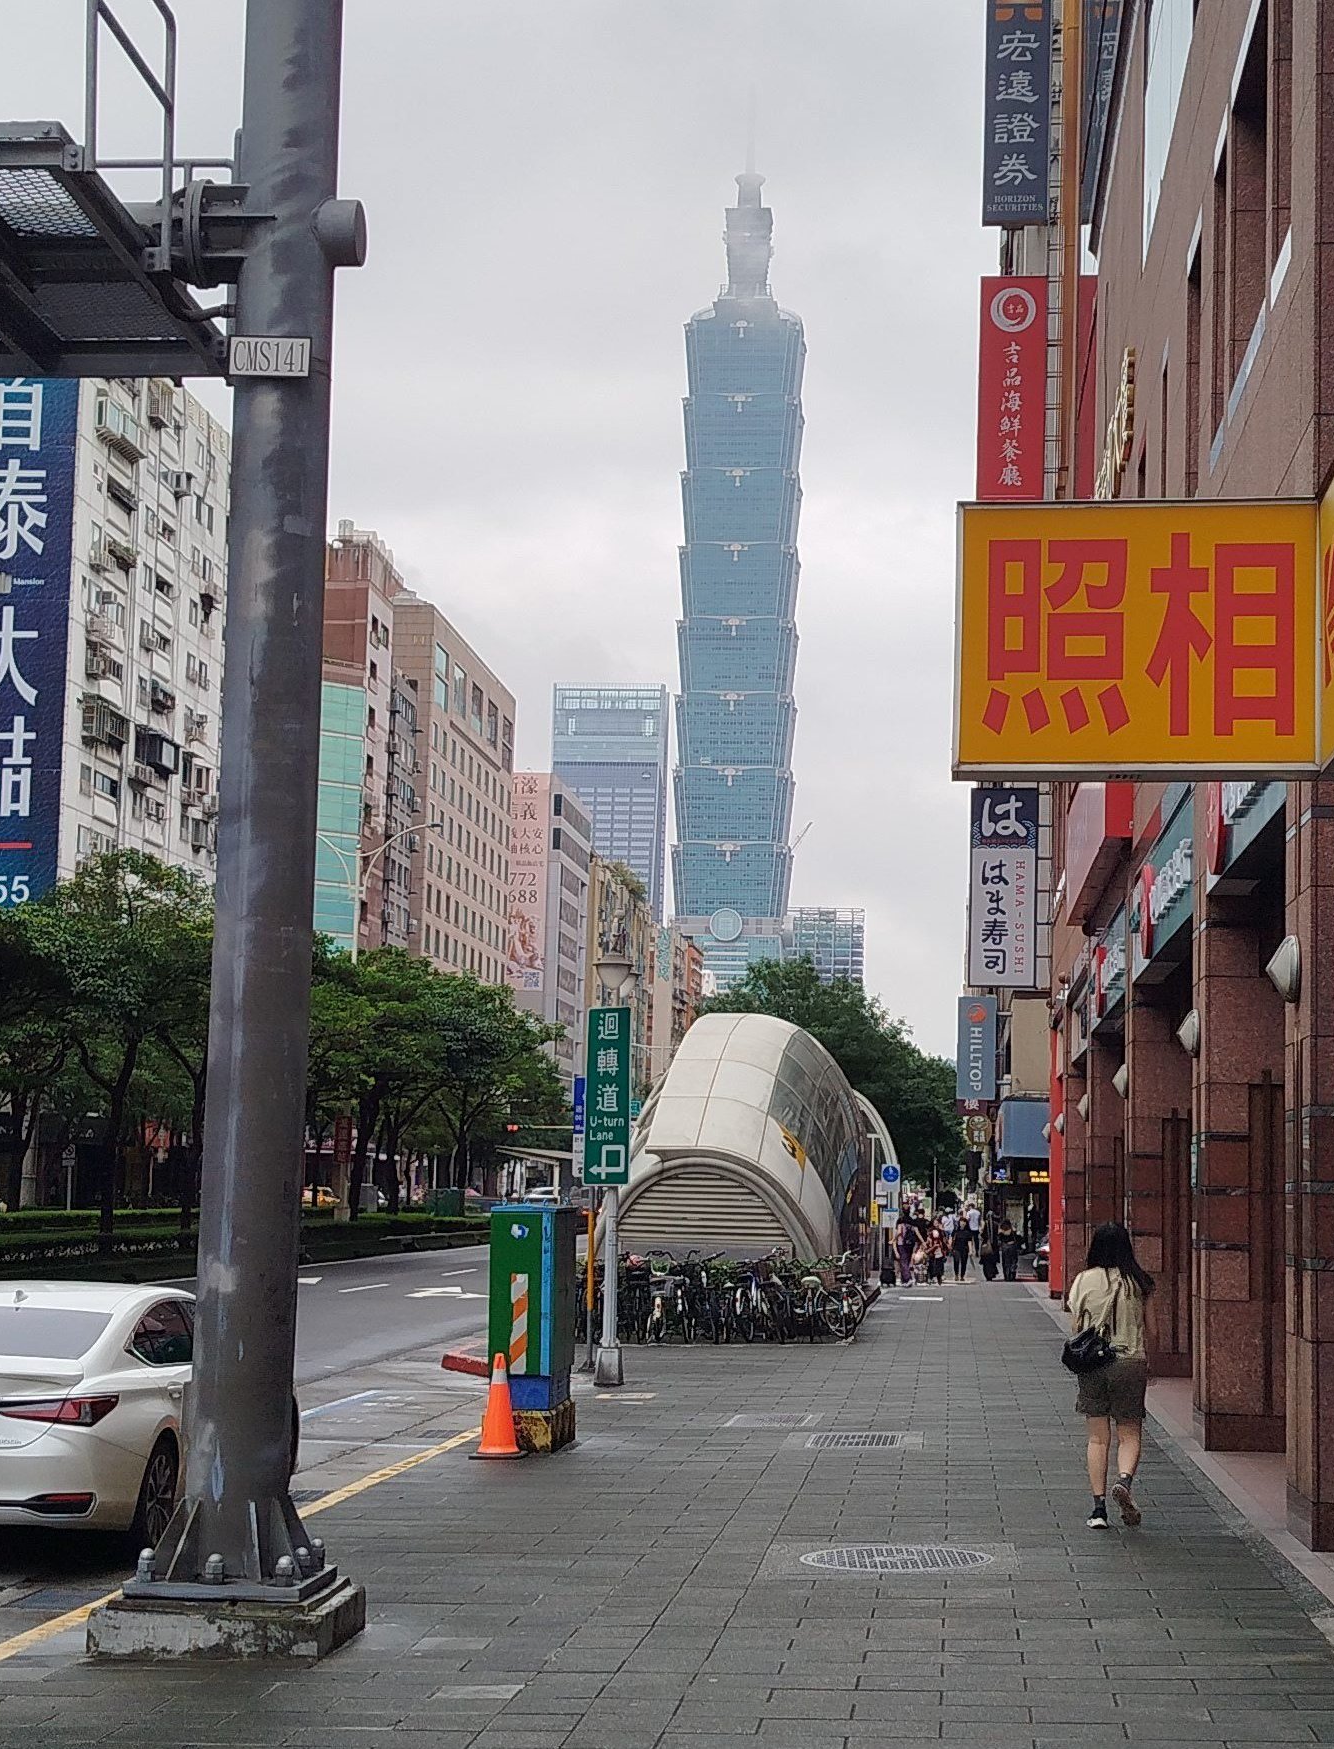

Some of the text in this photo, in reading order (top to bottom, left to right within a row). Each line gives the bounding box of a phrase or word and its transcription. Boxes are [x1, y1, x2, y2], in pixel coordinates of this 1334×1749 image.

[993, 30, 1041, 186] 宏遠證券
[994, 195, 1036, 203] HORIZON
[233, 340, 305, 373] CMS141
[998, 341, 1023, 487] 吉品海鮮餐廳
[13, 578, 45, 586] Mansion
[980, 532, 1295, 737] 照相
[981, 794, 1028, 838] は
[981, 859, 1010, 975] はま寿司
[1014, 860, 1026, 974] HAMA-SUSHI
[596, 1012, 621, 1112] 迴轉道
[969, 1027, 983, 1092] HILLTOP
[589, 1115, 625, 1128] U-turn
[589, 1130, 614, 1141] Lane
